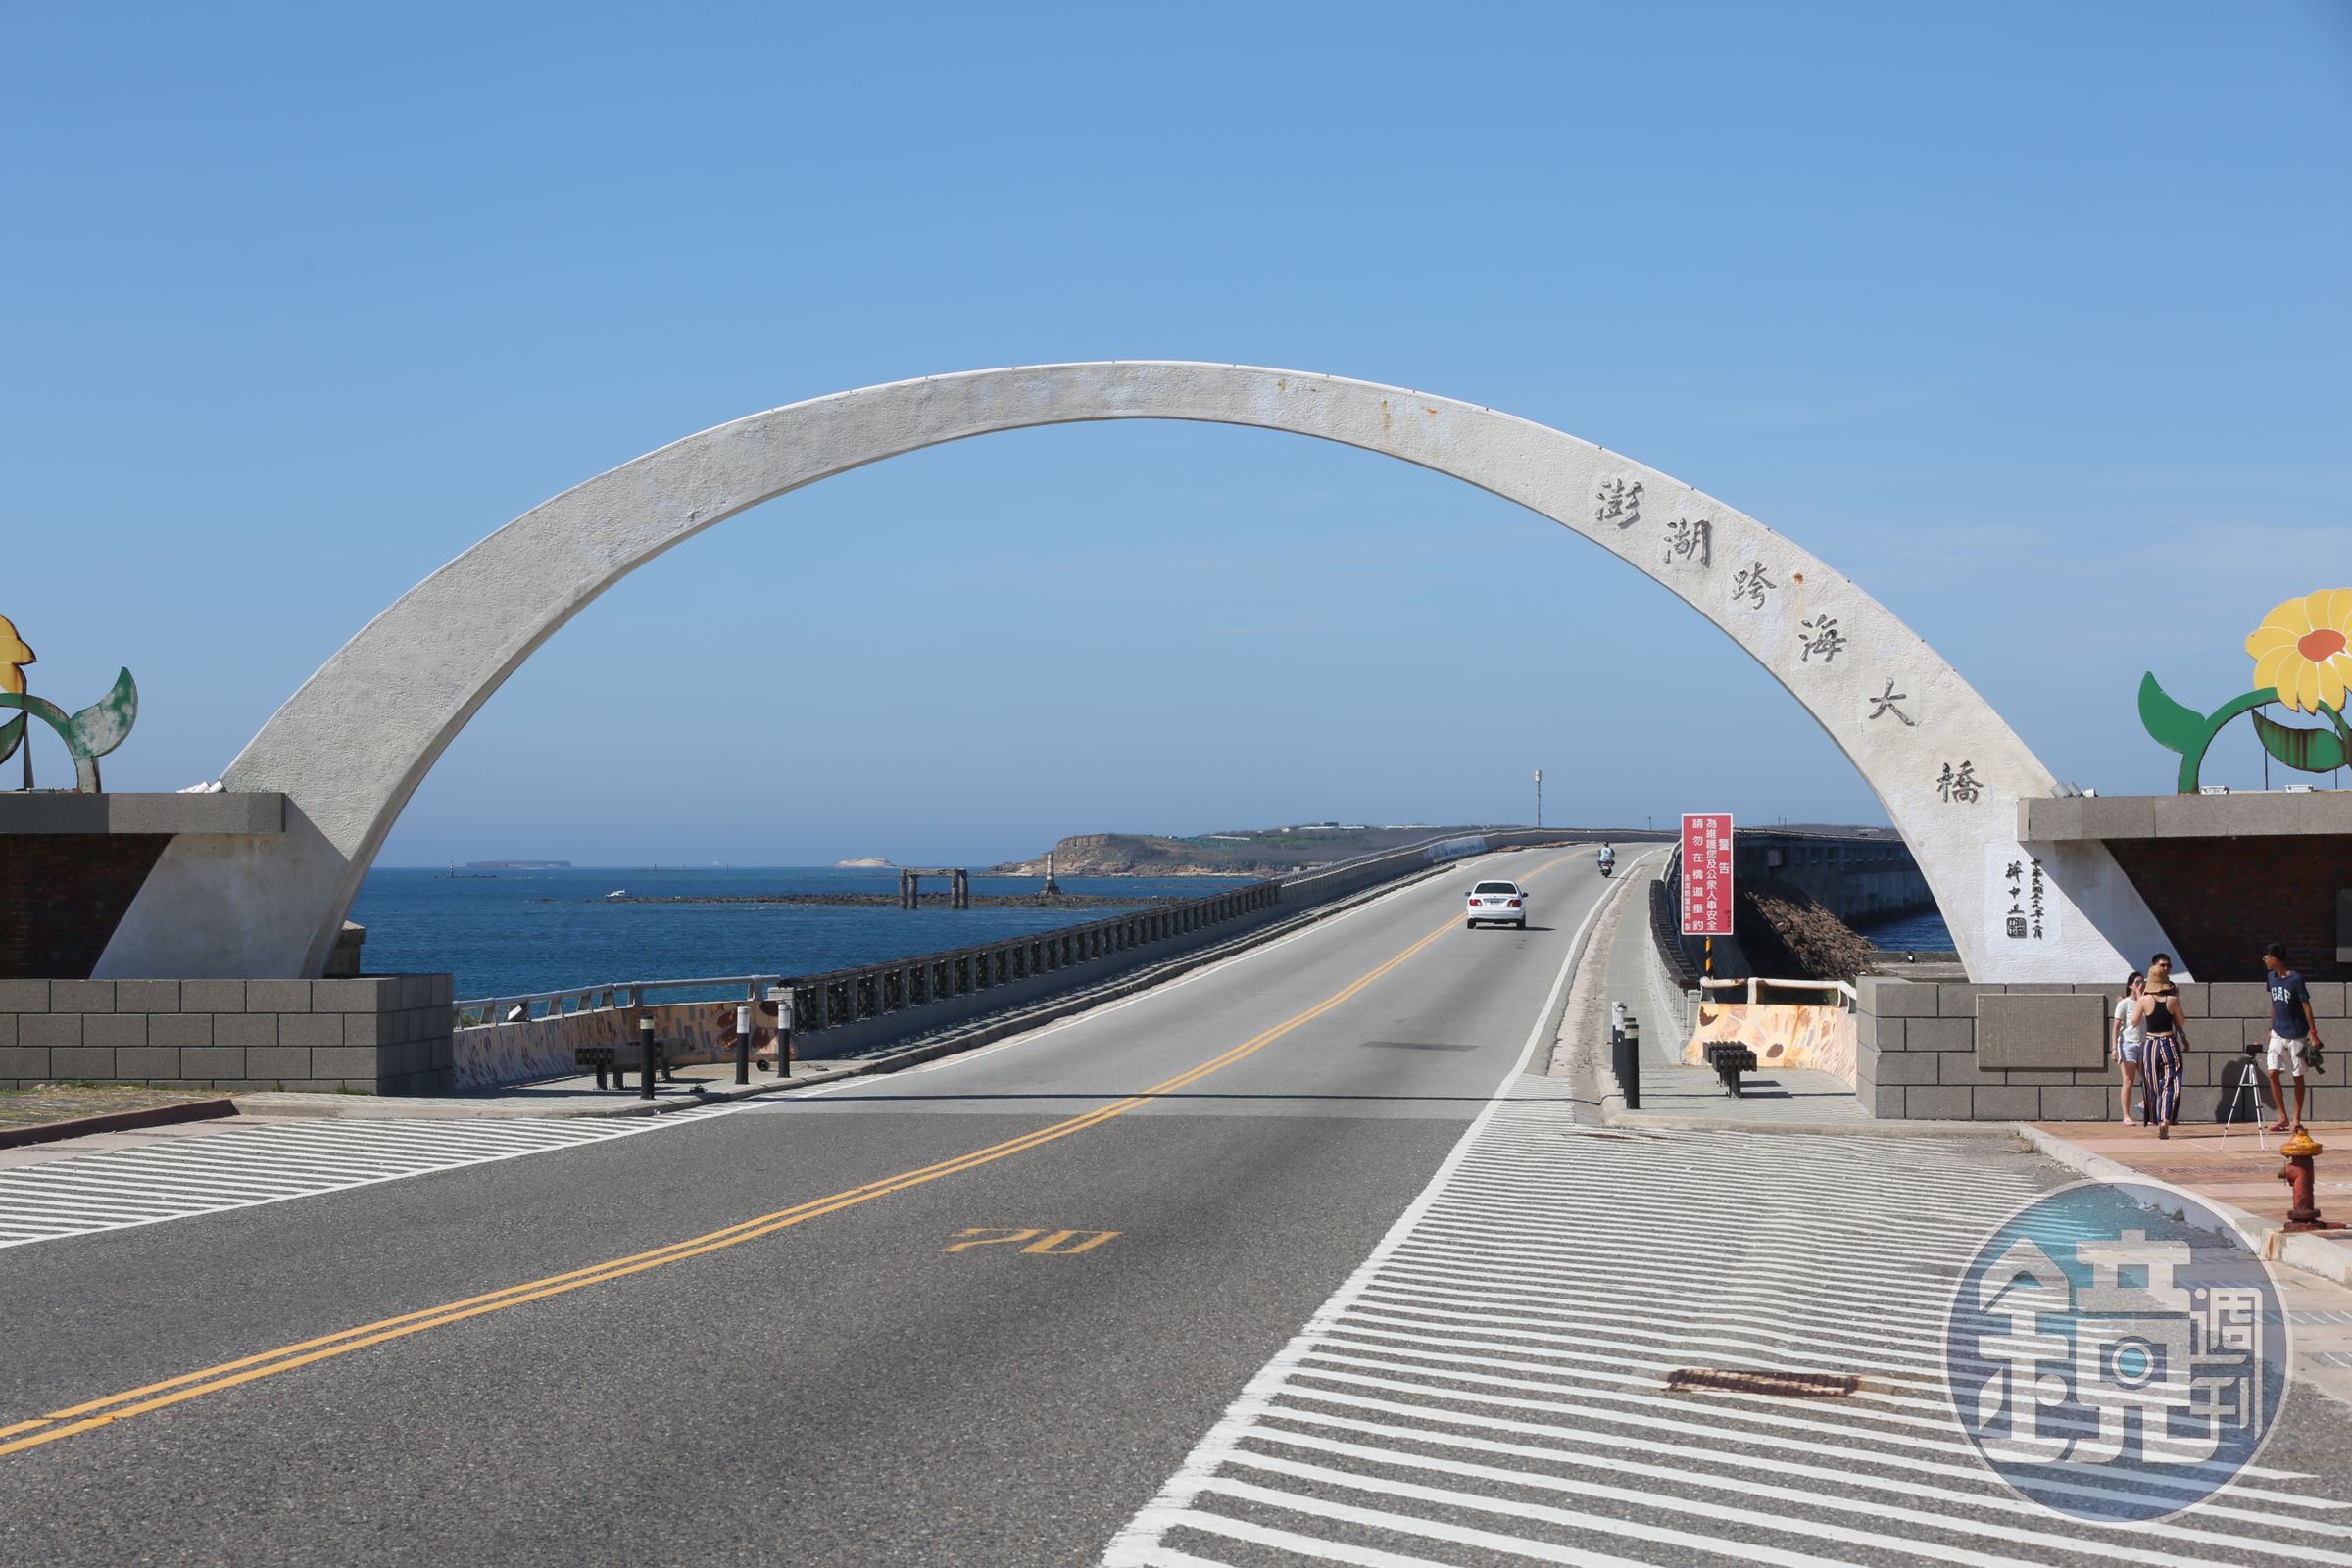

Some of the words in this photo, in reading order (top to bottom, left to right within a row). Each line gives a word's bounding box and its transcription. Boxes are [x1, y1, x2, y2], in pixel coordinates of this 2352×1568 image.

[1594, 478, 1984, 805] 澎湖跨海大橋
[1718, 838, 1730, 875] 警告
[2271, 986, 2291, 1004] GAP
